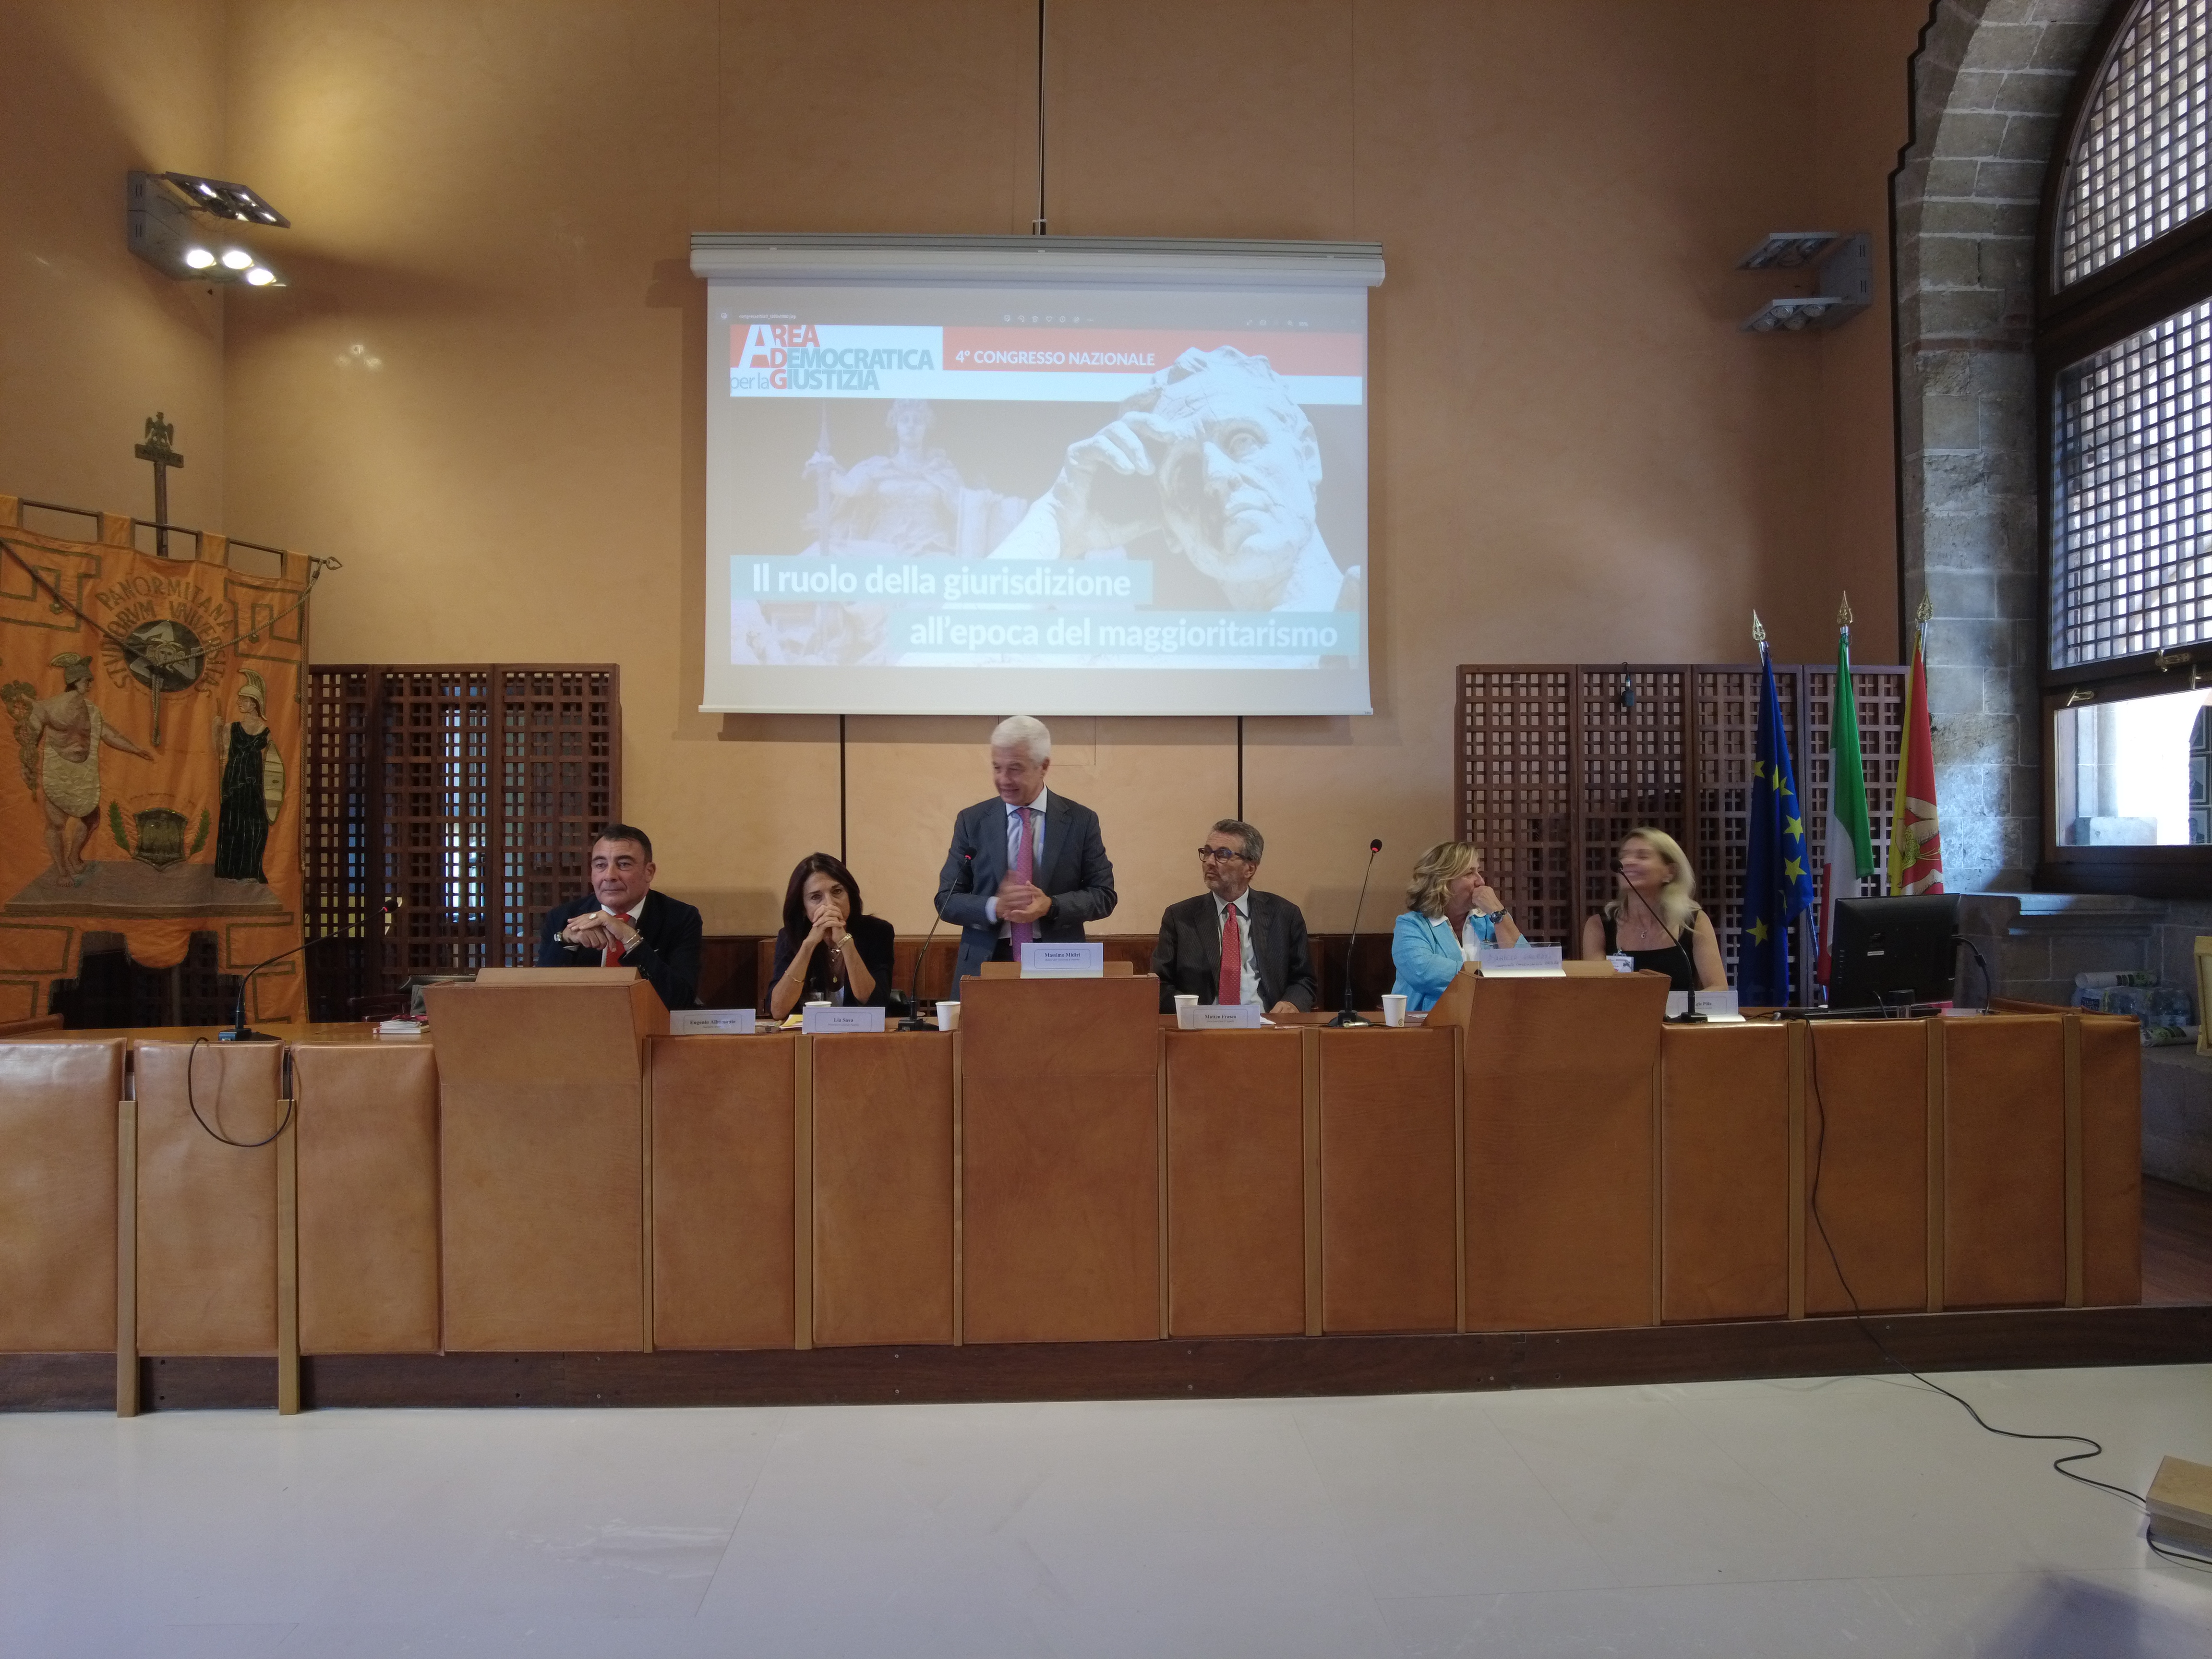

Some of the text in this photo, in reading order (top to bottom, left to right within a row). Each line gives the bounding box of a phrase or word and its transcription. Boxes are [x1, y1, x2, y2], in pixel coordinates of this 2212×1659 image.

[738, 324, 820, 368] AREA
[769, 348, 935, 370] DEMOCRATICA
[974, 350, 1066, 365] CONGRESSO
[1069, 352, 1155, 366] NAZIONALE
[730, 369, 880, 393] per la GIUSTIZIA
[753, 563, 1131, 601] Il ruolo della giurisdizione
[95, 576, 233, 633] PANORMITANA
[910, 615, 1338, 653] all'epoca del maggioritarismo
